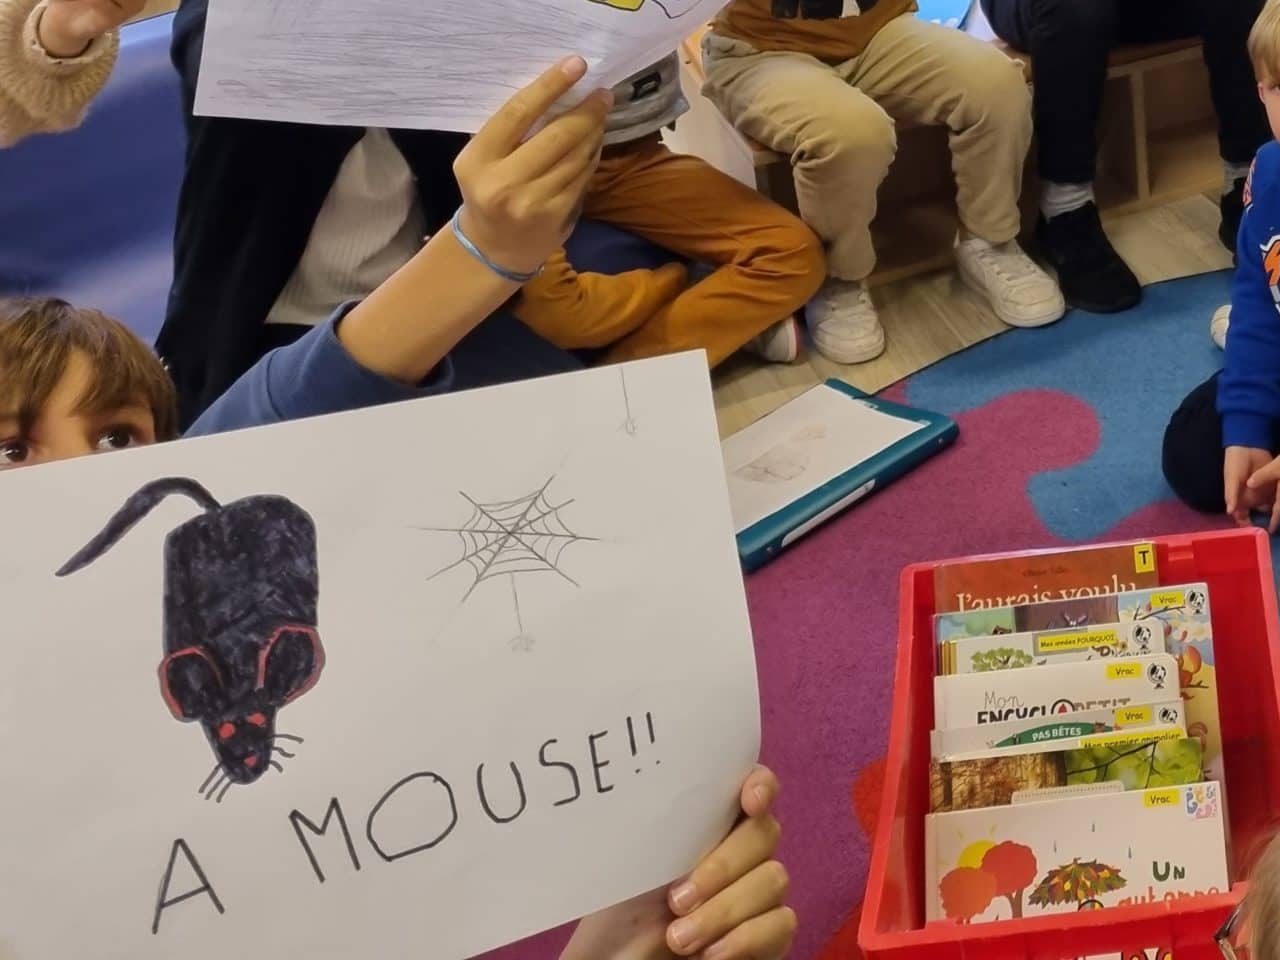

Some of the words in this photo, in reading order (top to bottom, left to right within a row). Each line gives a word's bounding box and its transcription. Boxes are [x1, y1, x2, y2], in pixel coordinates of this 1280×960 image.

[1138, 550, 1149, 566] T
[1158, 595, 1177, 605] Vrac
[1076, 634, 1115, 646] POURQUOI
[1115, 667, 1135, 675] Vrac
[983, 692, 1025, 711] Mon
[1124, 711, 1144, 720] Vrac
[1032, 730, 1050, 741] PAS
[1051, 725, 1082, 738] BÊTES
[1104, 738, 1139, 748] premier
[1149, 795, 1170, 804] Vrac
[152, 837, 225, 935] A
[288, 711, 663, 883] MOUSE!!
